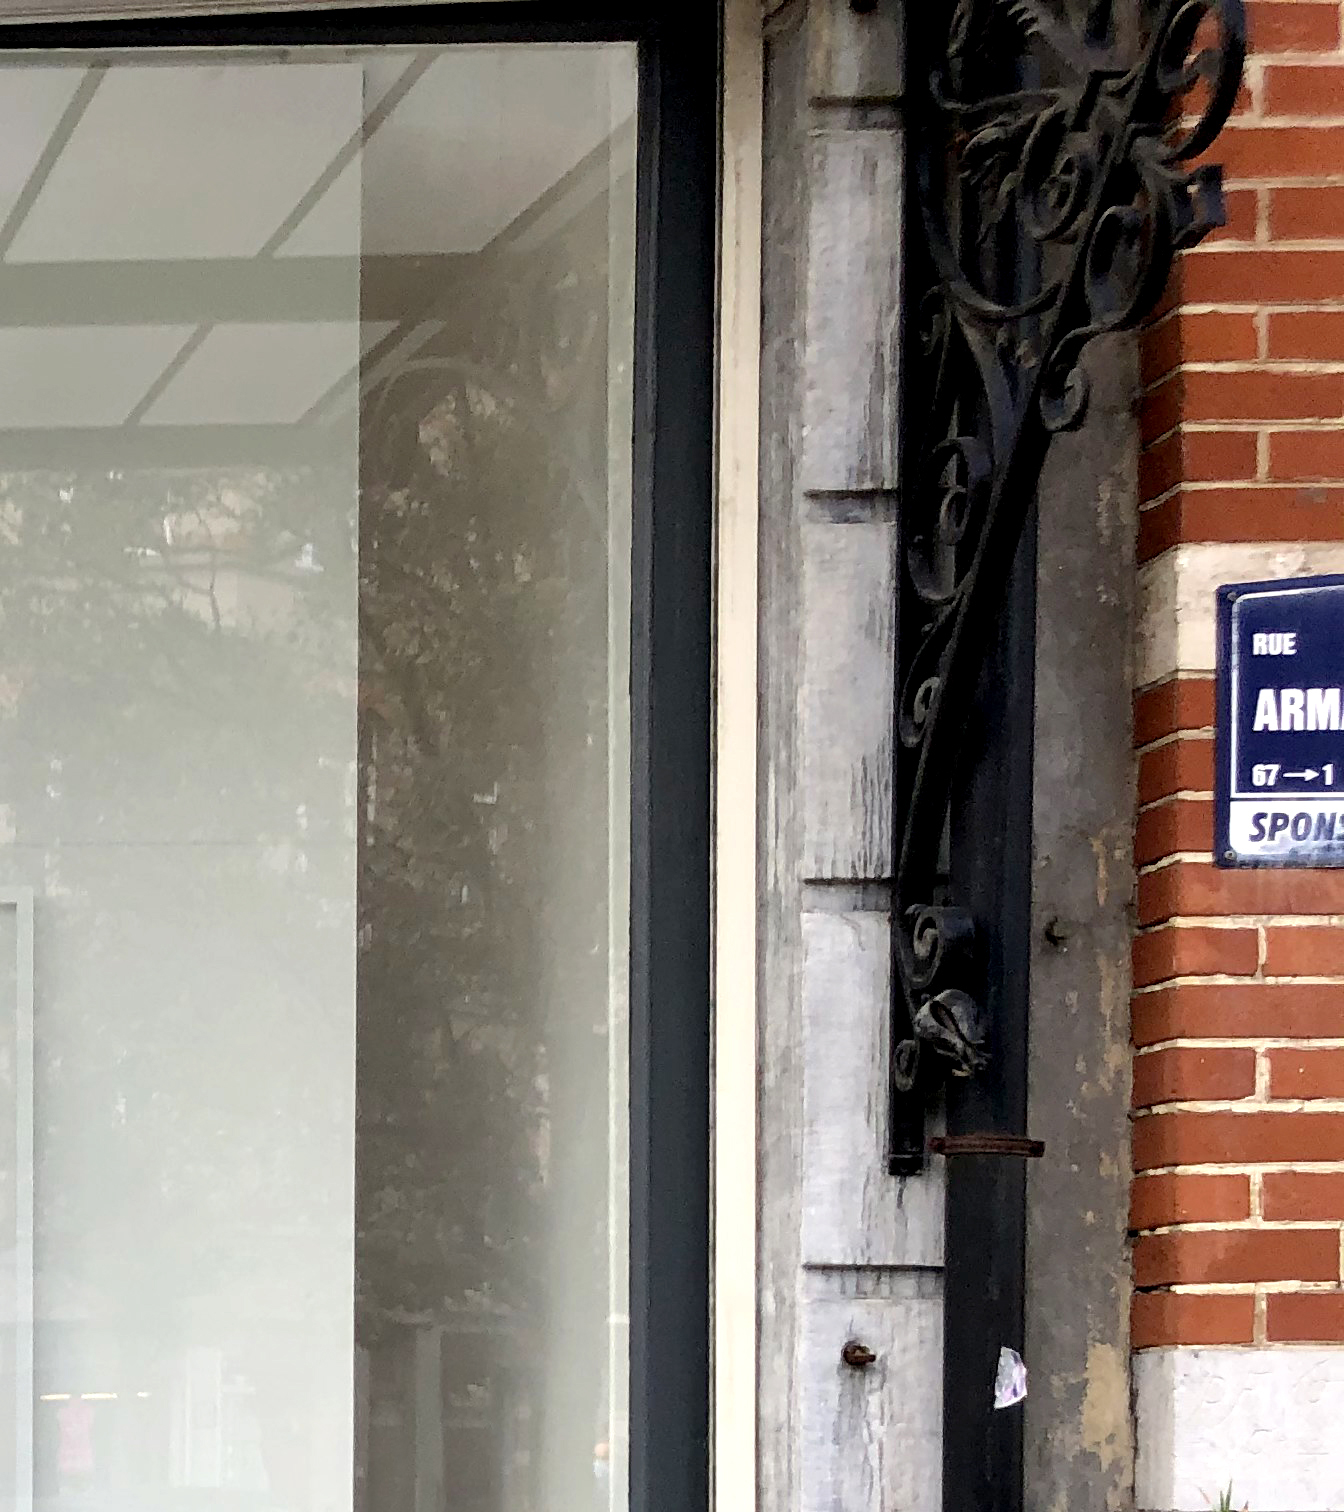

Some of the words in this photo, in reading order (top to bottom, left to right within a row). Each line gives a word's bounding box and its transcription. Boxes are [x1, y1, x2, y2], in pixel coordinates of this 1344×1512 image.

[1253, 633, 1297, 655] RUE
[1253, 688, 1344, 731] ARM
[1252, 764, 1281, 787] 67
[1322, 764, 1334, 786] 1
